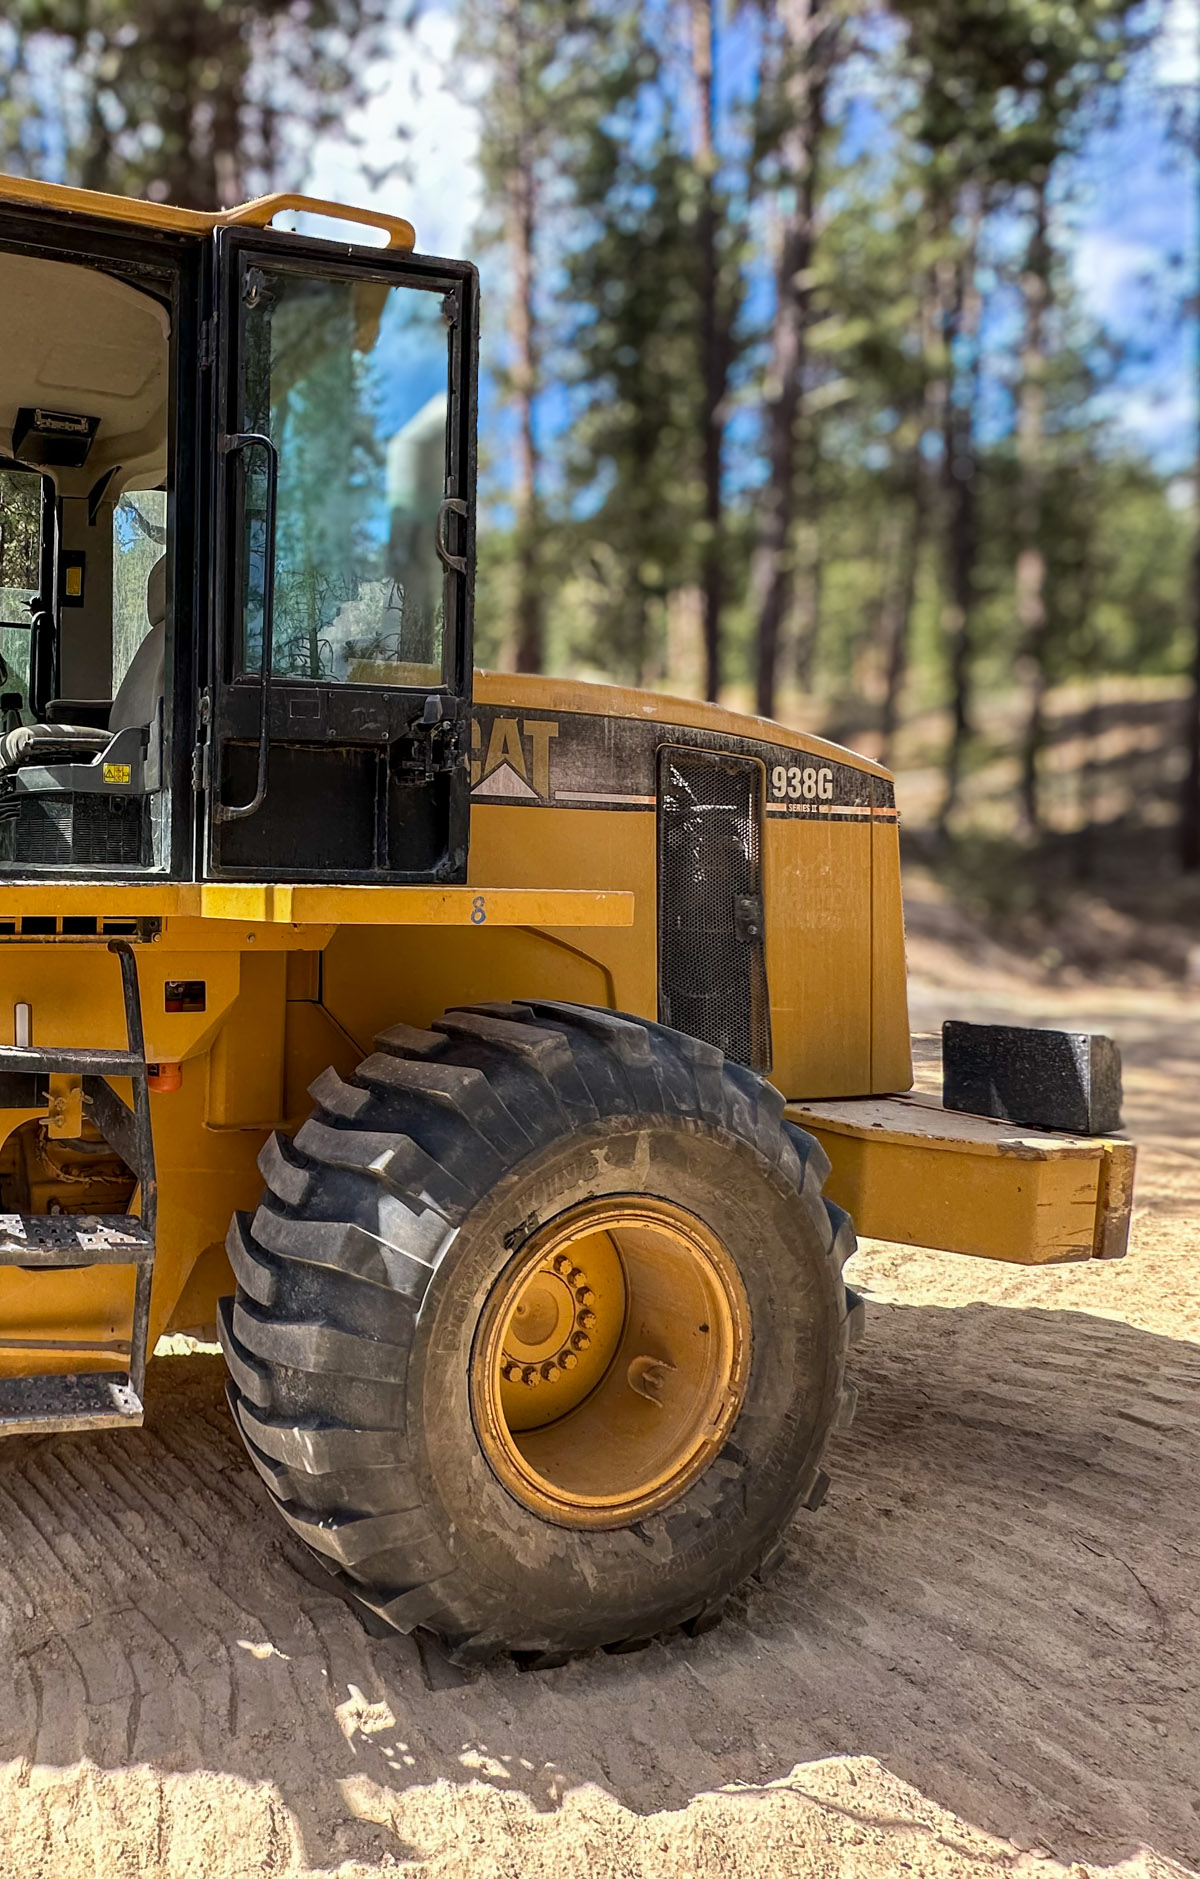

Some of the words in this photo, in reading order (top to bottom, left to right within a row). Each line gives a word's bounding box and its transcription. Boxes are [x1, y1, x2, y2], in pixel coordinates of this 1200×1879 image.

[772, 766, 833, 799] 938G
[788, 803, 810, 812] SERIES
[471, 896, 486, 924] 8
[437, 1220, 510, 1353] POWER
[514, 1155, 598, 1224] KING
